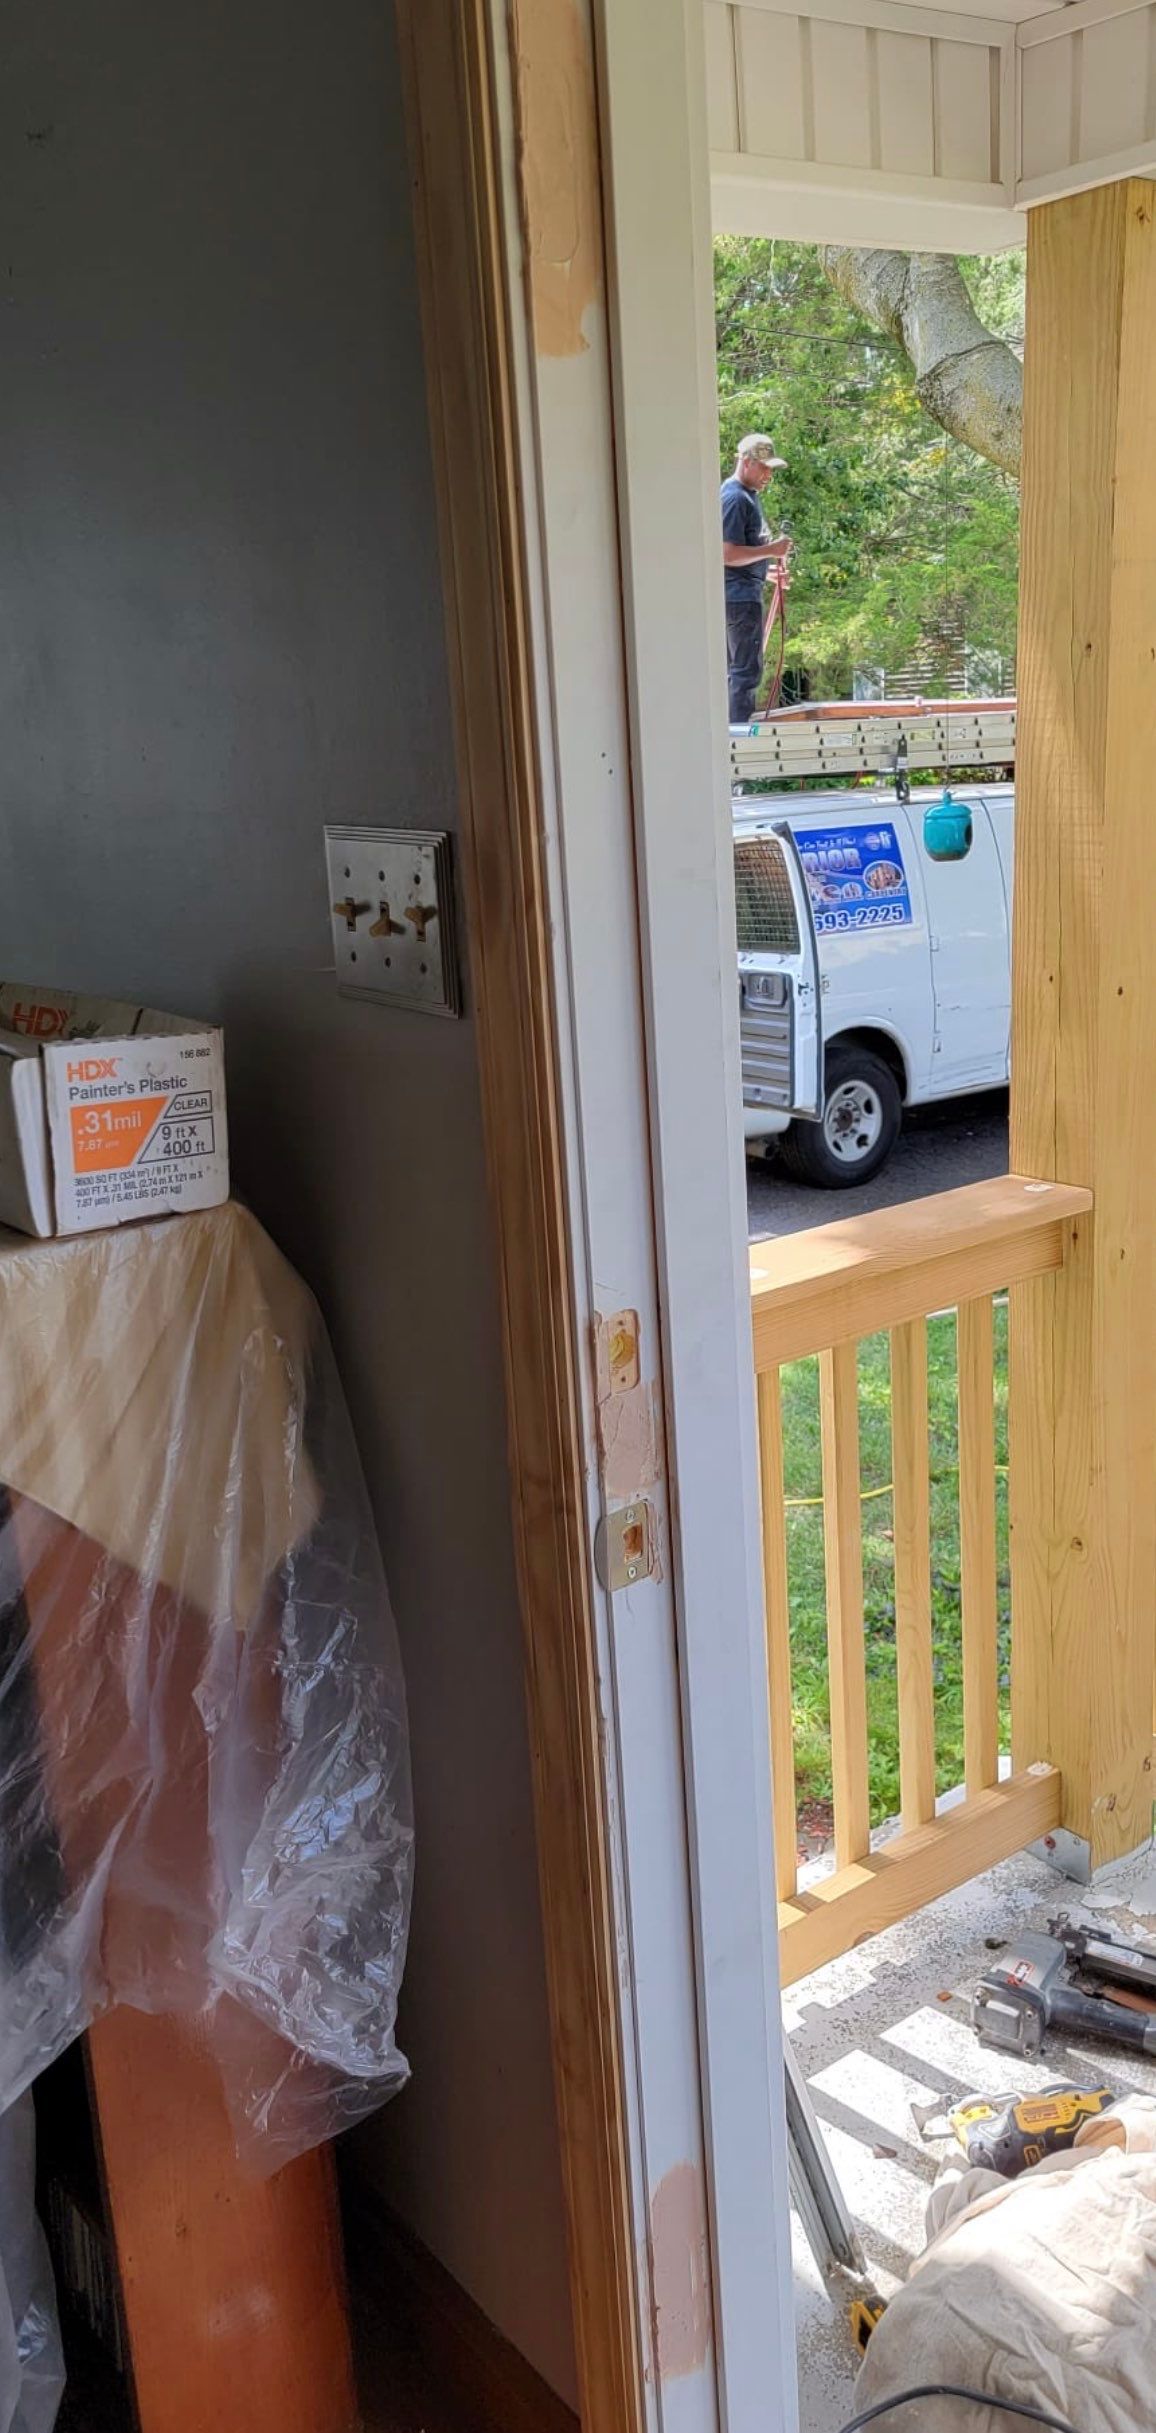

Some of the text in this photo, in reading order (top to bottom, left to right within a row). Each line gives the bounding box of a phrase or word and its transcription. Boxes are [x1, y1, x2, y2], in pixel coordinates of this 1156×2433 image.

[801, 847, 862, 874] RIOR
[69, 1076, 188, 1100] Painter's Plastic
[174, 1098, 208, 1111] CLEAR
[161, 1125, 198, 1140] 9 ft X
[163, 1139, 206, 1156] 400 ft
[108, 1173, 117, 1182] FT
[162, 1164, 171, 1174] FT
[91, 1186, 100, 1195] FT
